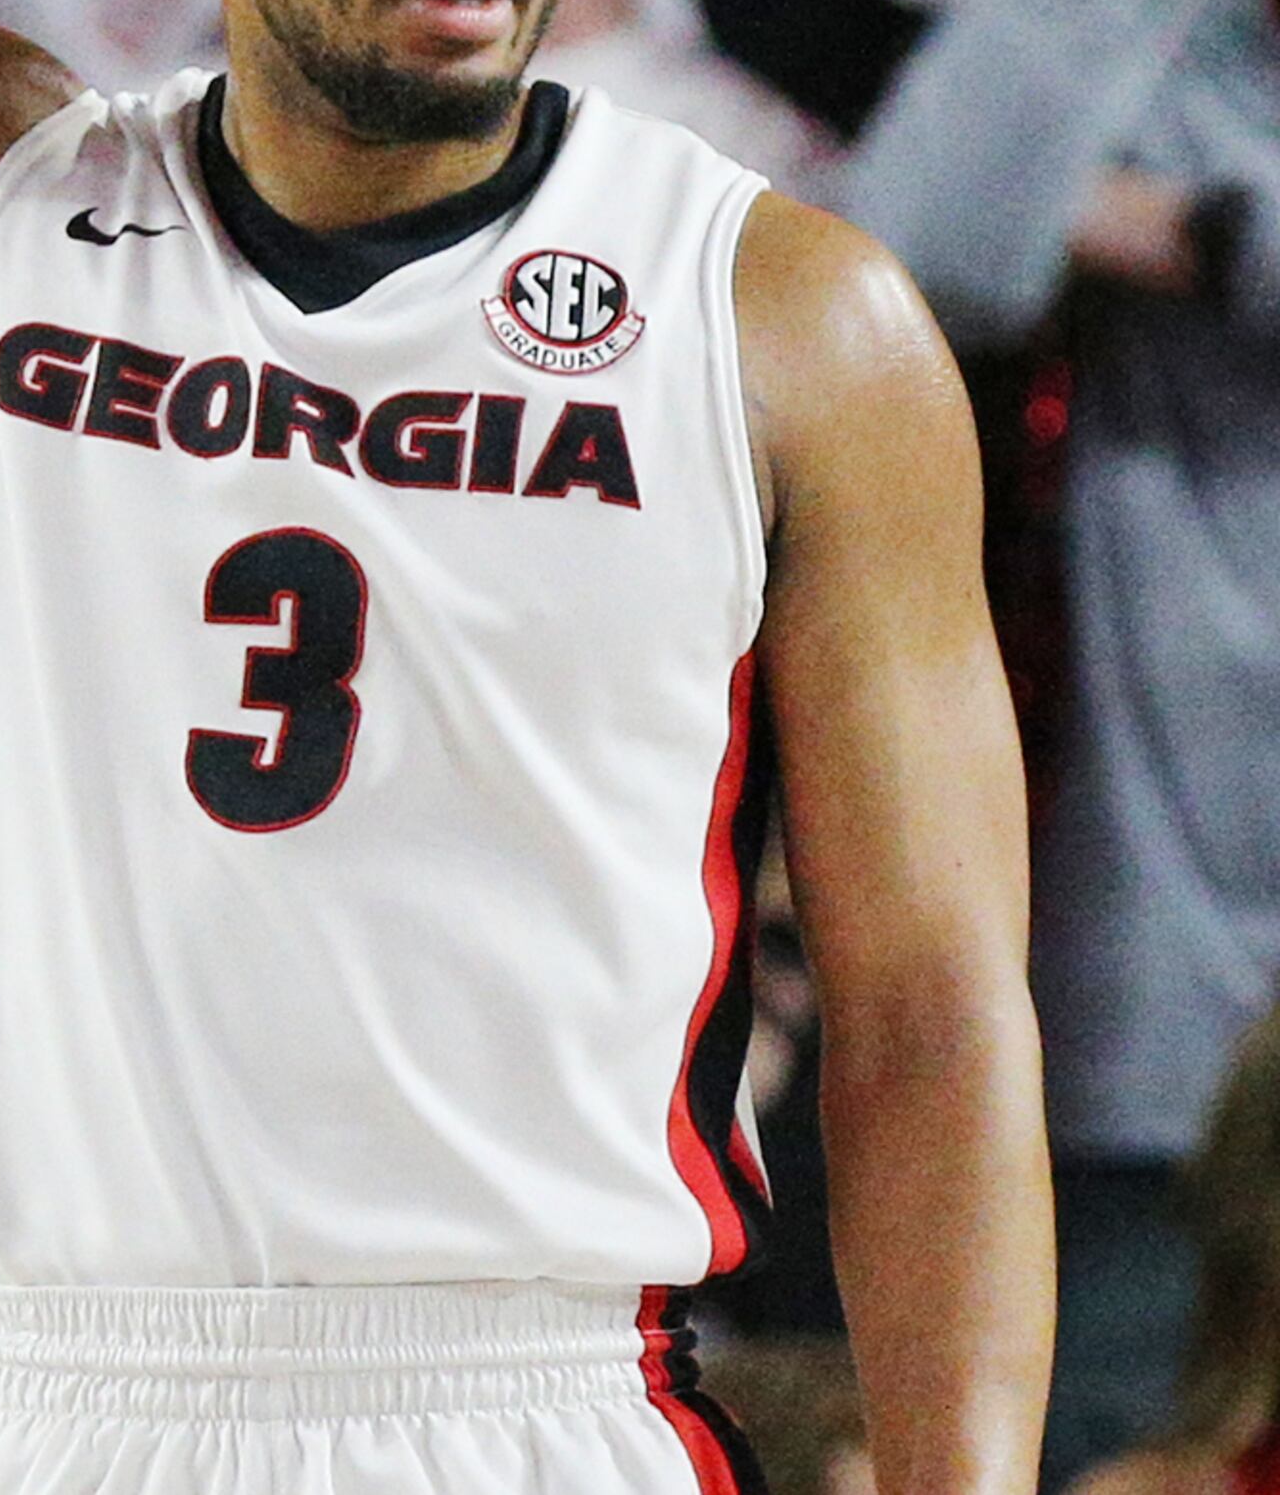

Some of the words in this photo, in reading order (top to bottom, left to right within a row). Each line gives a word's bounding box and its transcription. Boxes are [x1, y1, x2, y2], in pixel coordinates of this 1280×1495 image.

[515, 254, 618, 340] SEC
[498, 320, 622, 369] GRADUATE
[184, 526, 369, 833] 3
